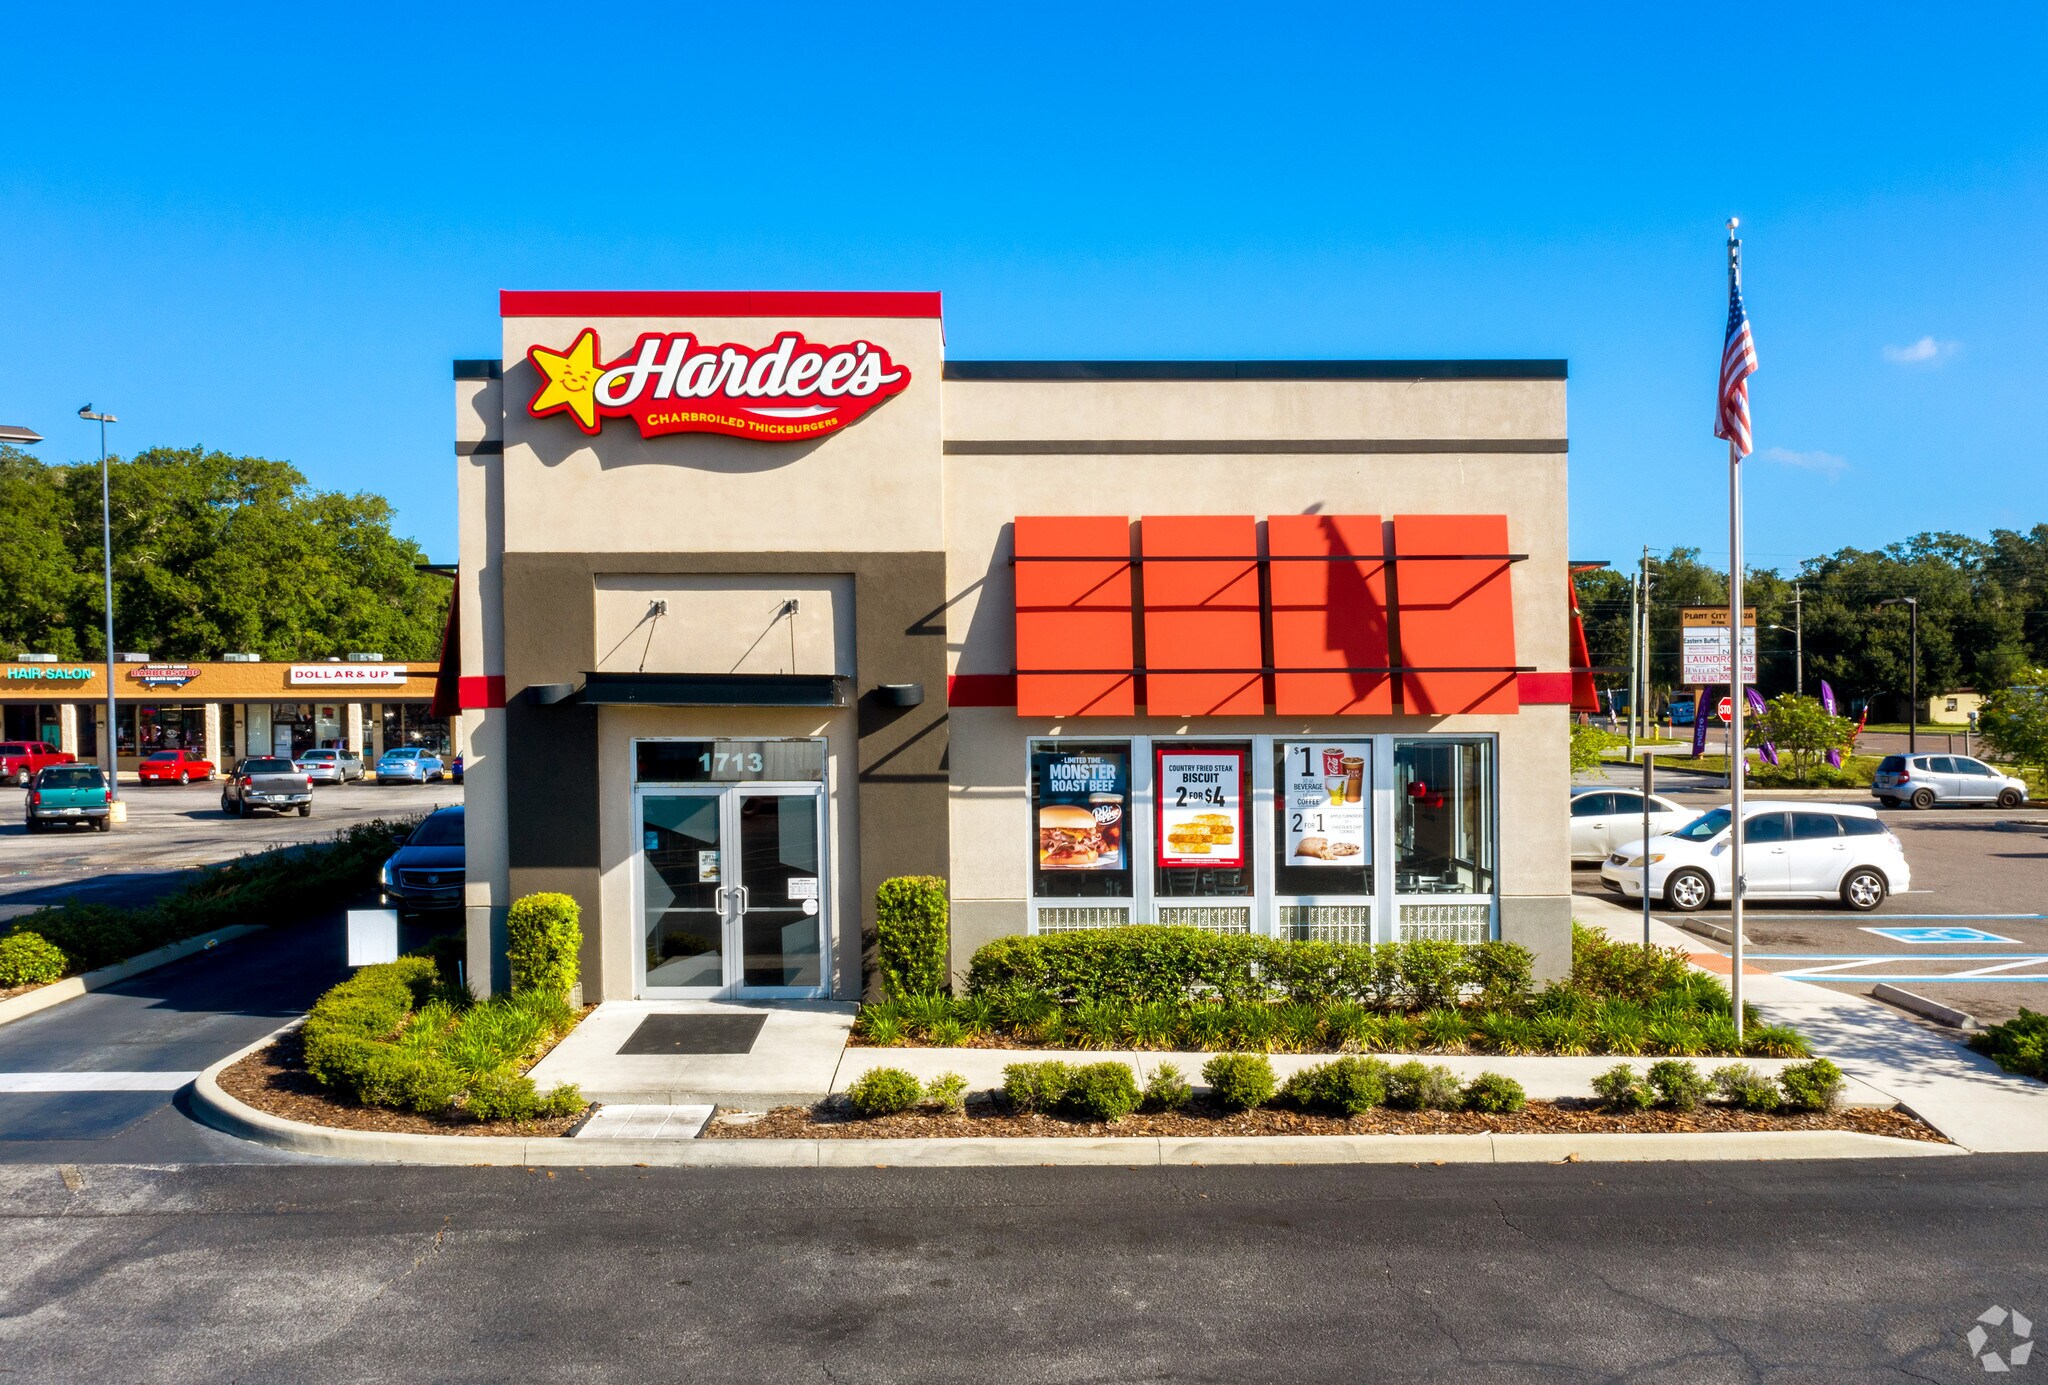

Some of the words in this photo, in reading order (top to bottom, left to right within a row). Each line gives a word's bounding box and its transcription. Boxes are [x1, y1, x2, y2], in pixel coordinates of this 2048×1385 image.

[593, 338, 902, 407] Hardee's
[647, 413, 746, 429] CHARBROILED
[748, 417, 839, 434] THICKBURGERS
[8, 668, 41, 679] HAIR
[46, 668, 92, 679] SALON
[131, 669, 201, 677] BARBERSHOP
[1720, 705, 1731, 714] STO
[698, 752, 763, 772] 1713
[1050, 764, 1116, 780] MONSTER
[1182, 773, 1220, 783] BISCUIT
[1052, 780, 1086, 792] ROAST
[1089, 780, 1114, 792] BEEF
[1176, 786, 1188, 807] 2
[1189, 792, 1204, 800] FOR
[1205, 786, 1226, 807] $4
[1292, 814, 1303, 832] 2
